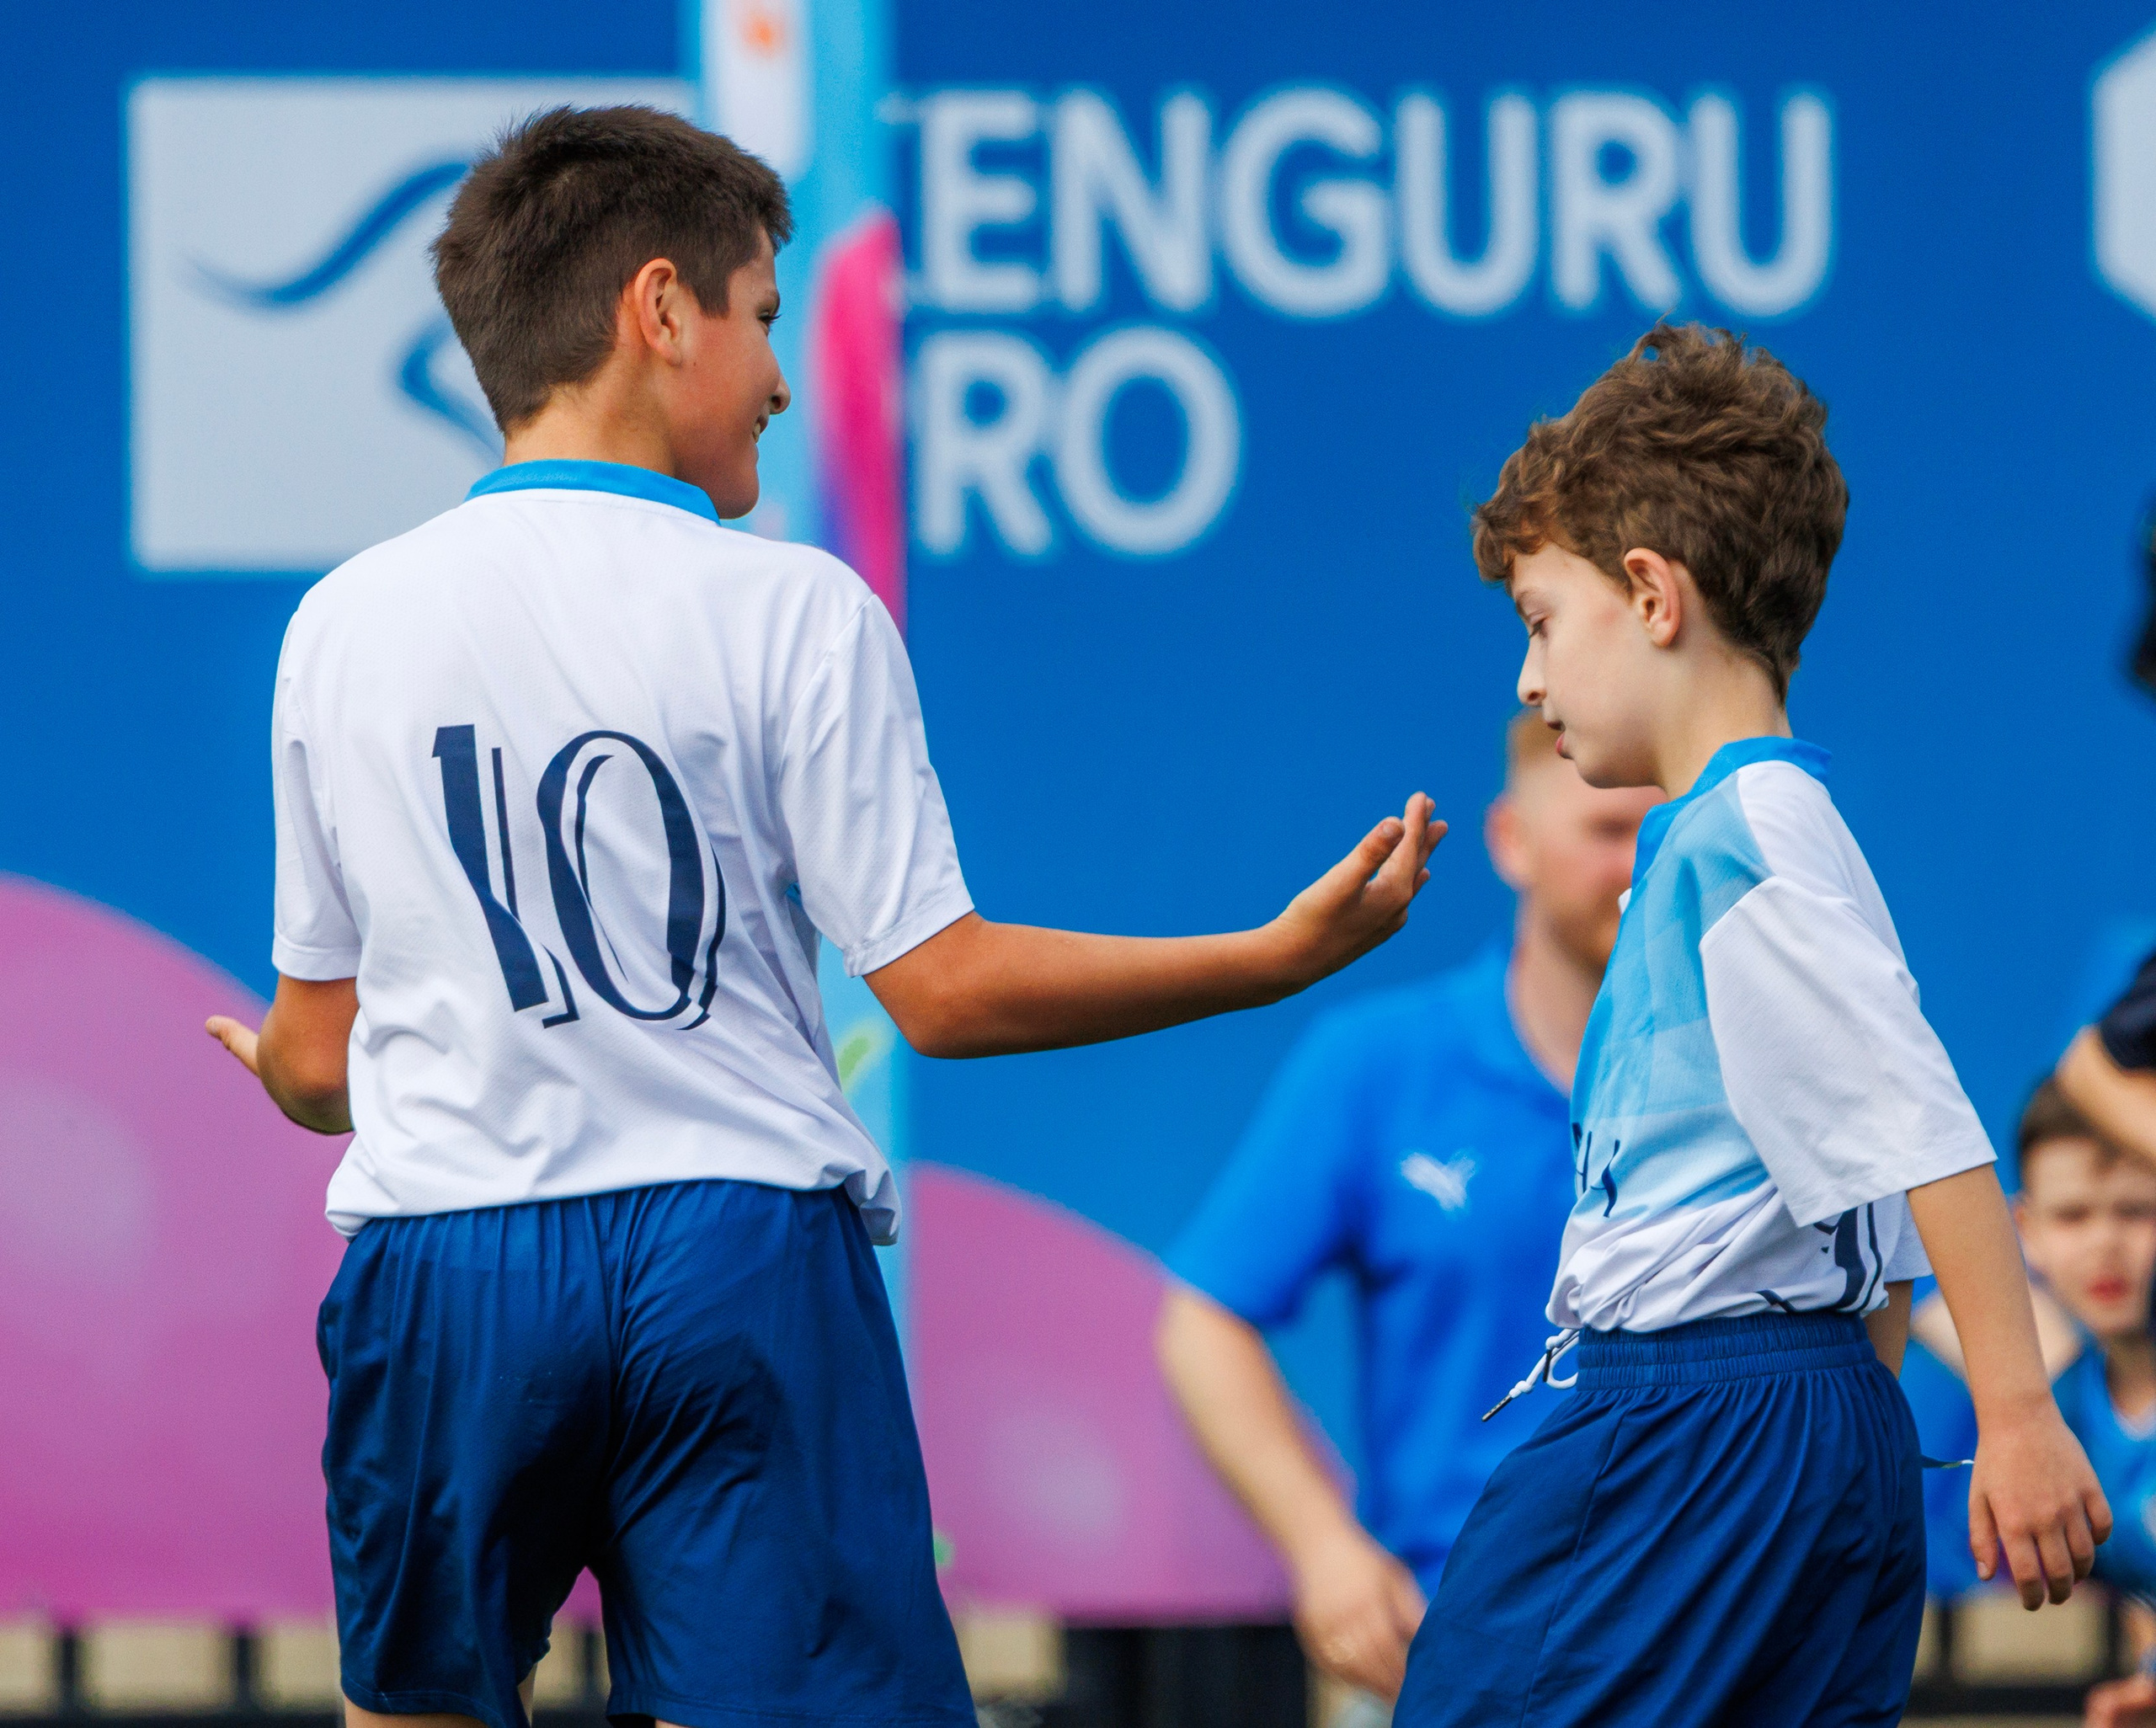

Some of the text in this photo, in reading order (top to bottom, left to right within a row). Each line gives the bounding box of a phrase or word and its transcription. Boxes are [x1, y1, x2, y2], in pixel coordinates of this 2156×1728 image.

[879, 88, 1832, 315] ENGURU
[916, 328, 1240, 556] RO
[431, 723, 727, 1031] 10
